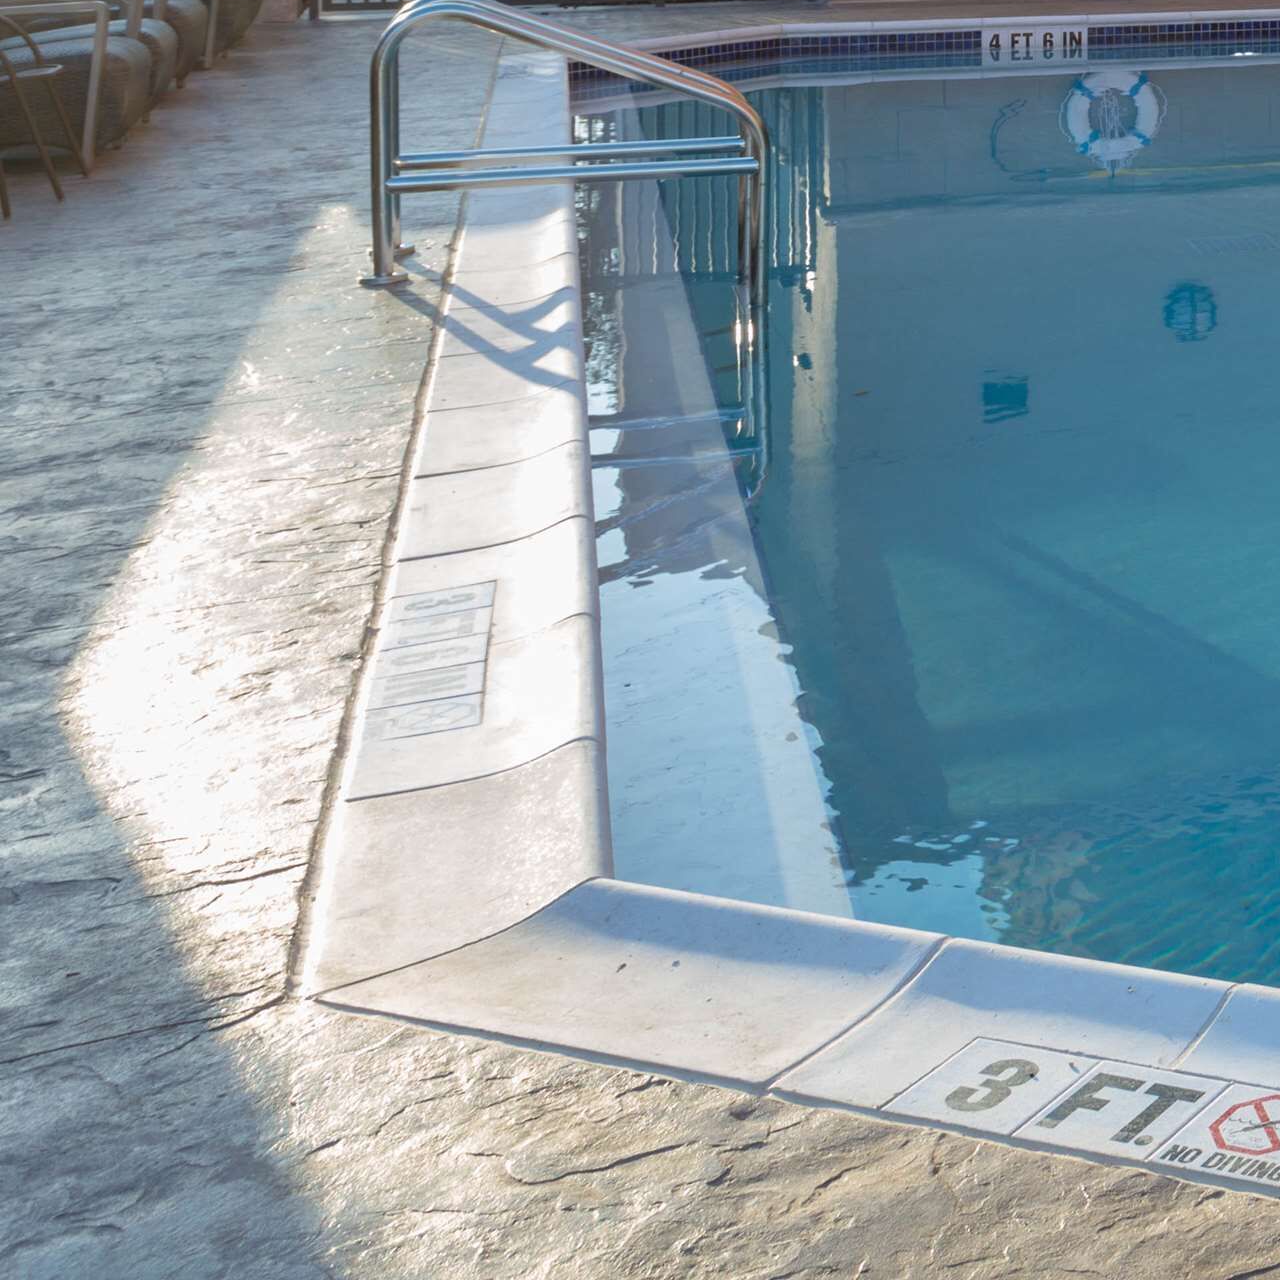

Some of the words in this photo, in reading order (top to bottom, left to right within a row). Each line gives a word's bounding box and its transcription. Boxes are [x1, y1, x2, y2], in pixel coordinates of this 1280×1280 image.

[988, 33, 1001, 49] 4
[1010, 33, 1034, 49] FT
[1042, 32, 1054, 49] 6
[1062, 31, 1083, 49] IN
[945, 1058, 1040, 1112] 3
[1037, 1072, 1206, 1147] FT.
[1159, 1144, 1198, 1164] NO
